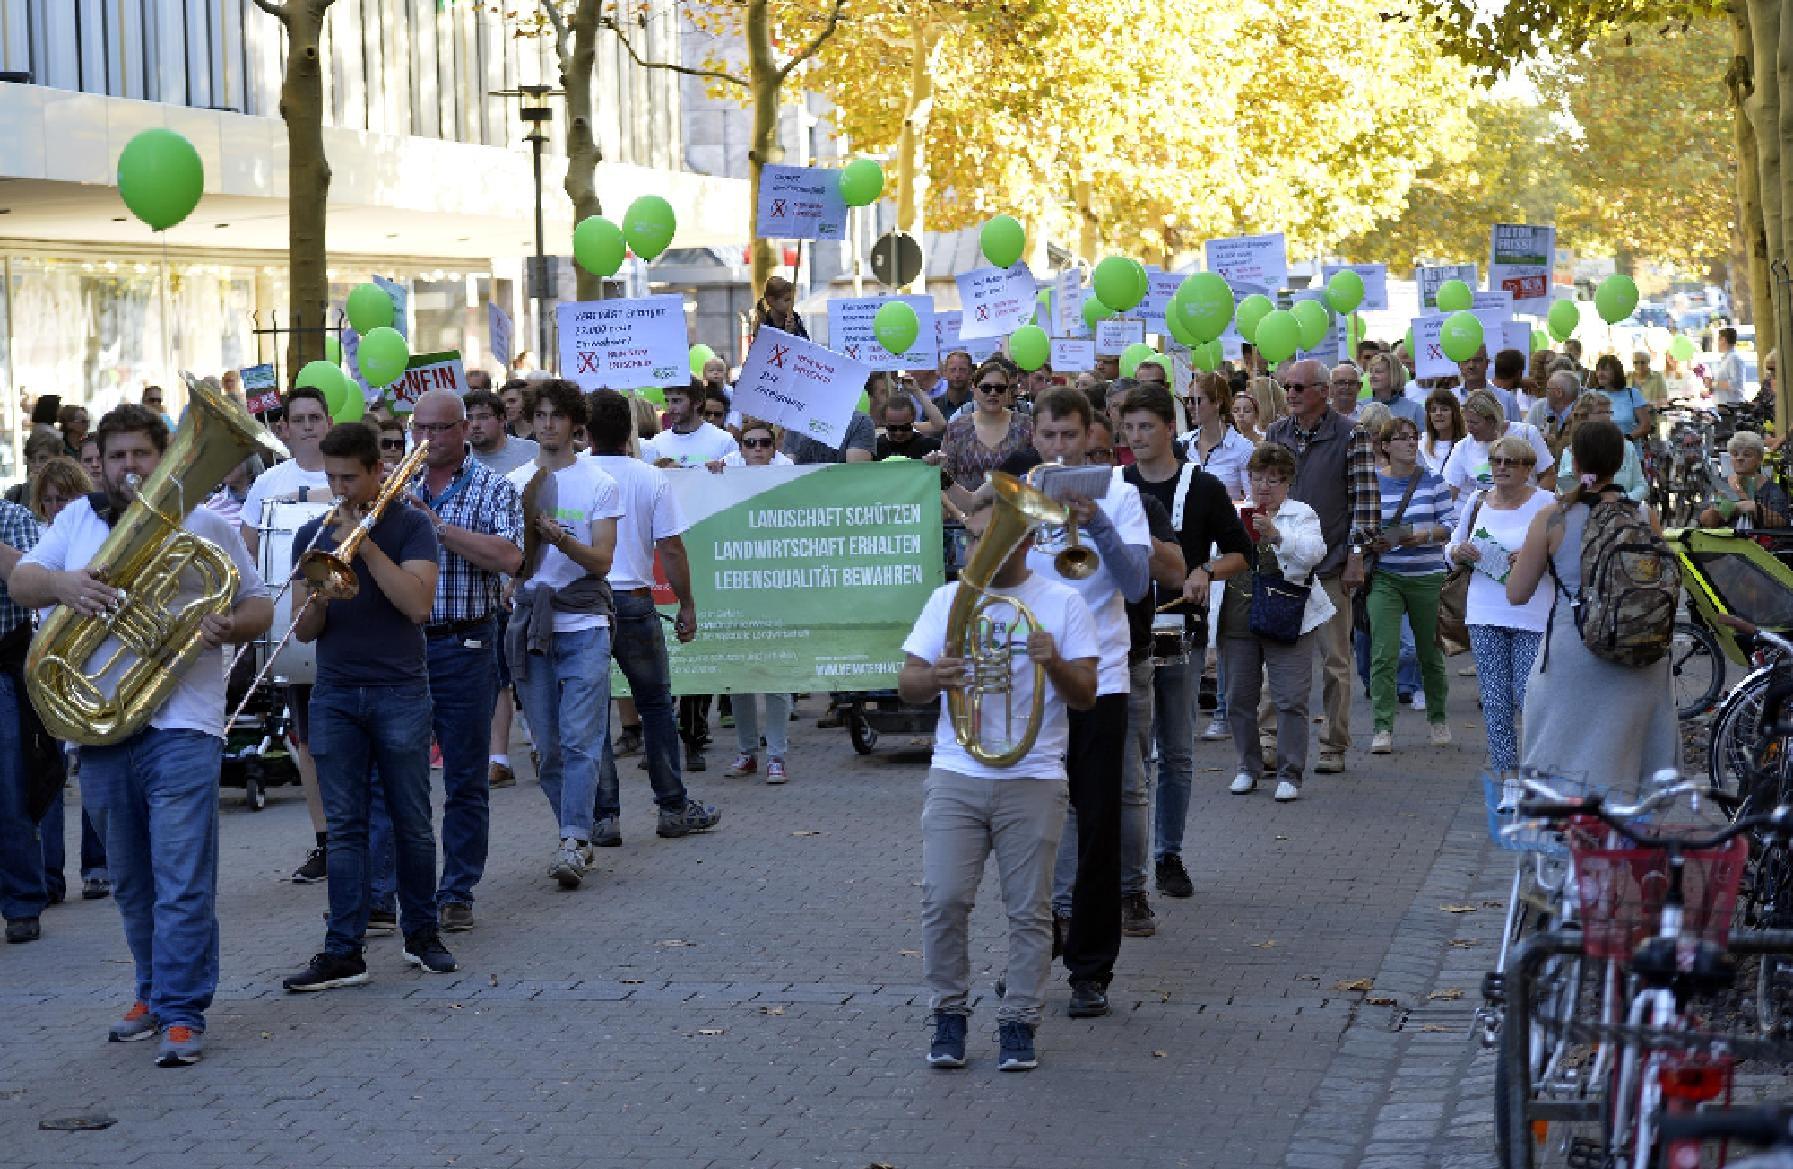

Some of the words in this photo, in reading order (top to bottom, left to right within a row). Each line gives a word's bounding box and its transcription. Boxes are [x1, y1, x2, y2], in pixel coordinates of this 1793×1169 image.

[748, 507, 843, 528] LANDSCHAFT
[845, 502, 921, 526] SCHÜTZEN
[714, 537, 846, 561] LANDWIRTSCHAFT
[849, 534, 921, 555] ERHALTEN
[714, 564, 838, 589] LEBENSQUALITÄT
[842, 564, 923, 586] BEWAHREN
